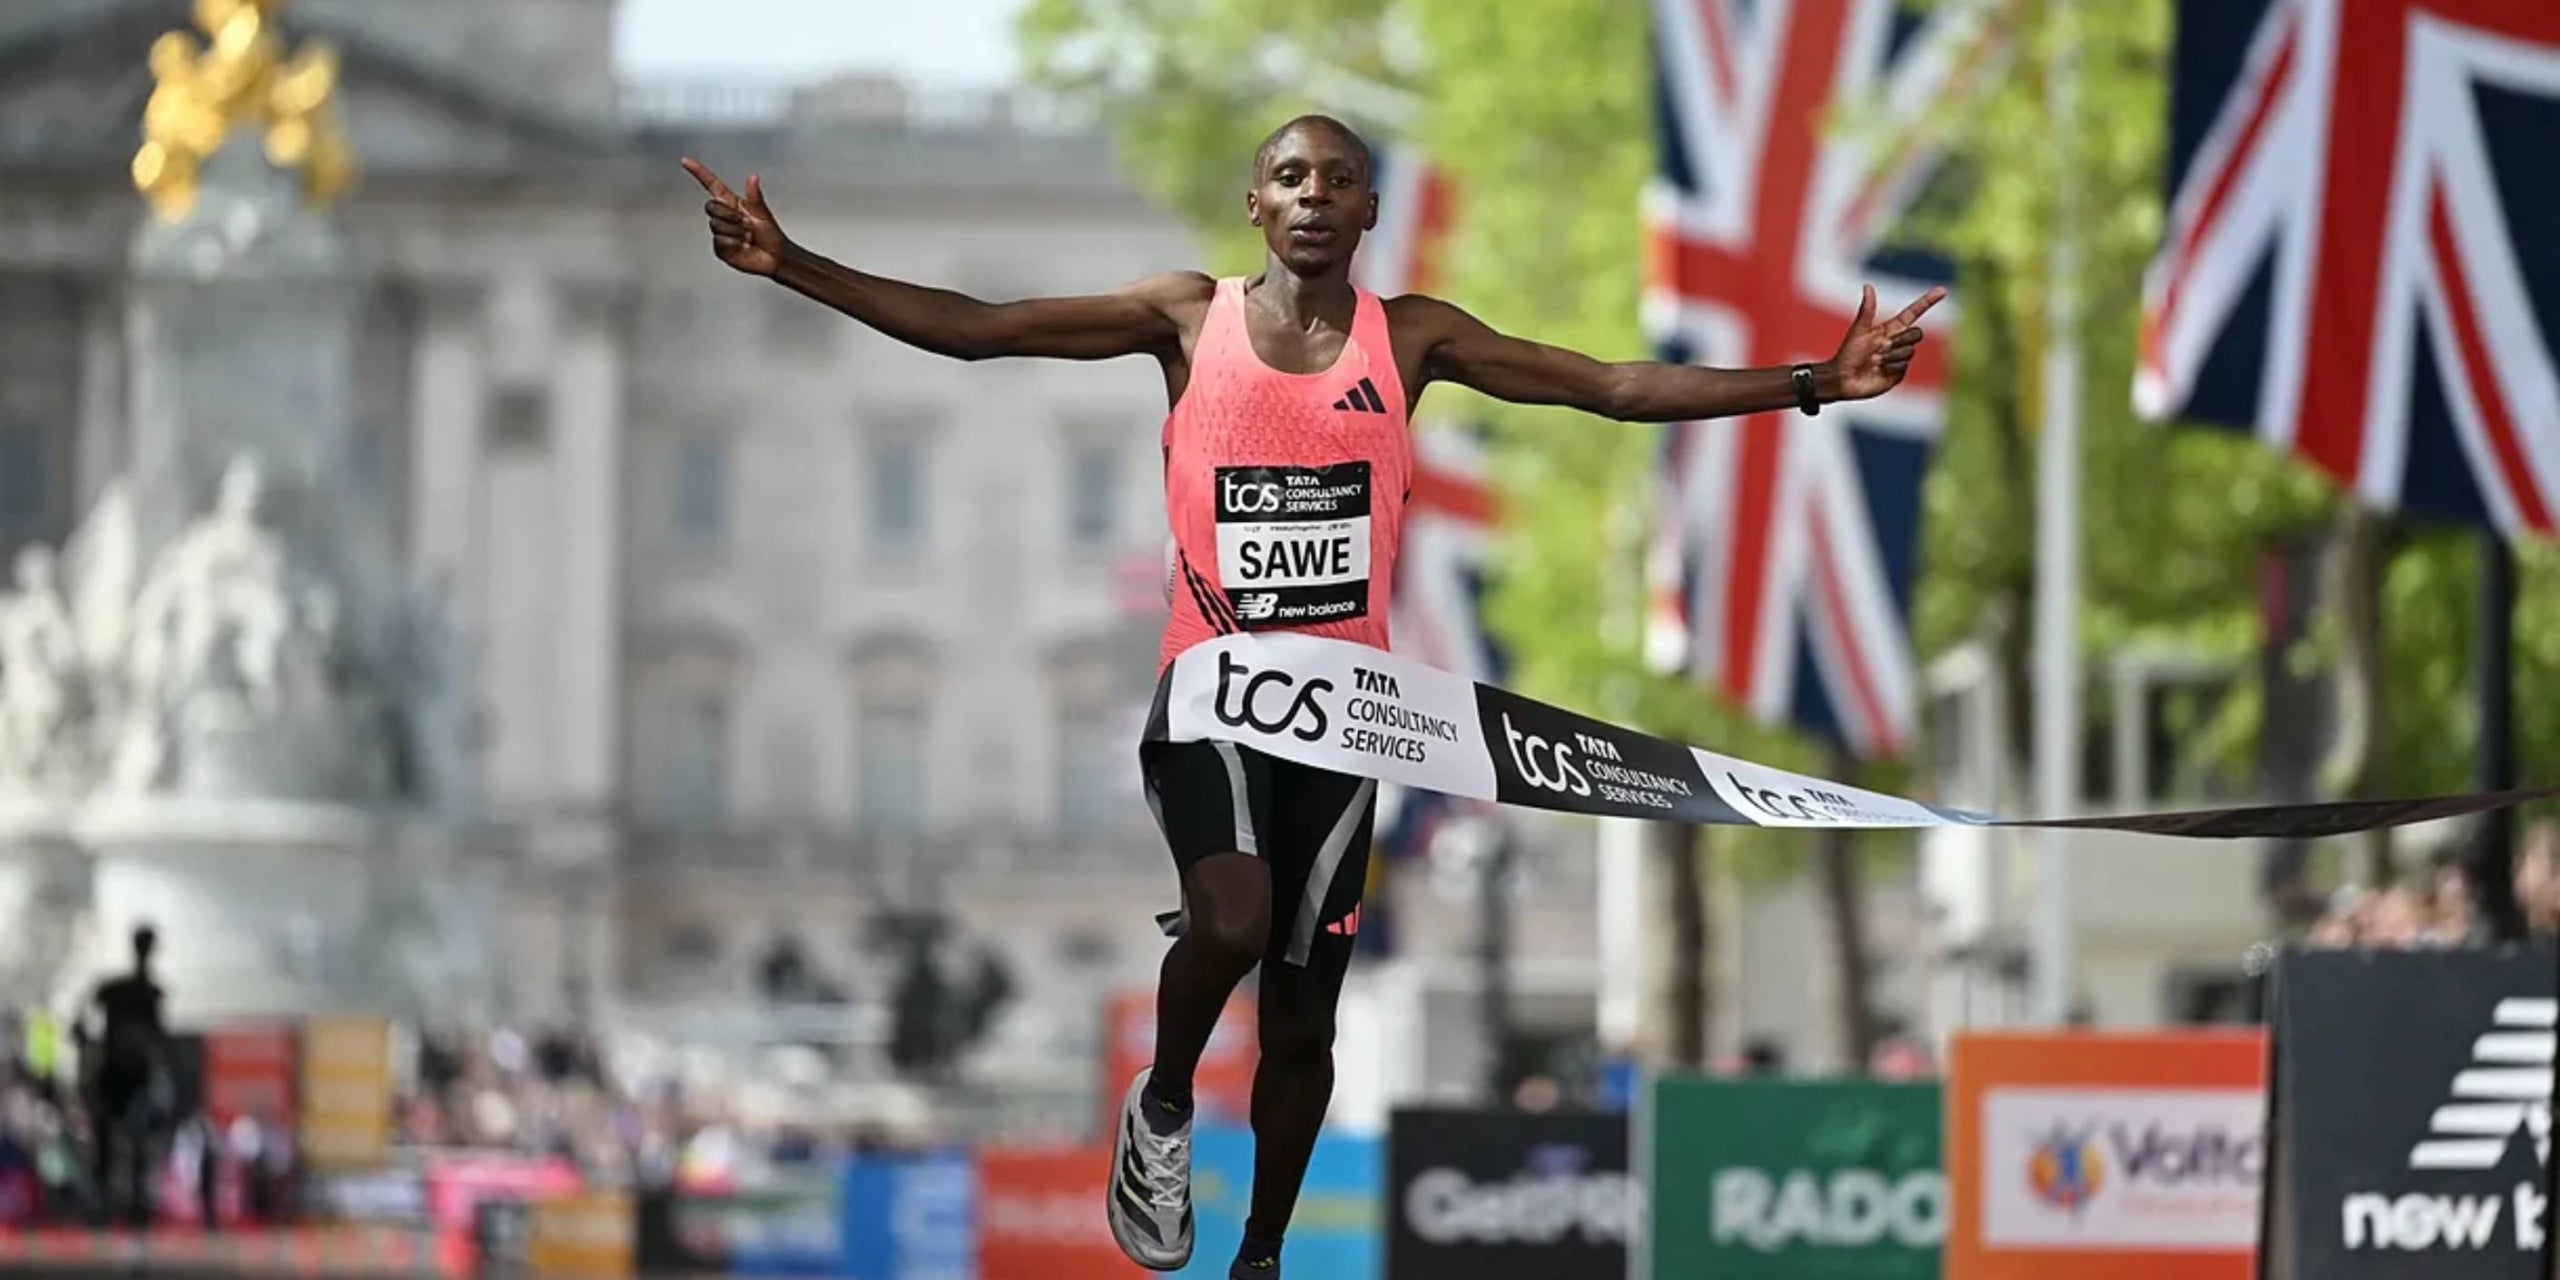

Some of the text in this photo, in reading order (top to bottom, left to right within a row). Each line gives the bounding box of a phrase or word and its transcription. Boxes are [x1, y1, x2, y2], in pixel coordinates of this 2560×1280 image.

[1224, 475, 1280, 513] tcs
[1285, 475, 1321, 486] TATA
[1285, 484, 1363, 500] CONSULTANCY
[1285, 499, 1338, 513] SERVICES
[1239, 537, 1351, 580] SAWE
[1278, 600, 1357, 618] new balance
[1214, 650, 1334, 742] tcs
[1352, 667, 1401, 699] TATA
[1346, 697, 1459, 743] CONSULTANCY
[1340, 727, 1426, 763] SERVICES
[1502, 711, 1592, 797] tcs
[1574, 732, 1623, 763] TATA
[1585, 759, 1693, 797] CONSULTANCY
[1598, 783, 1674, 809] SERVICES
